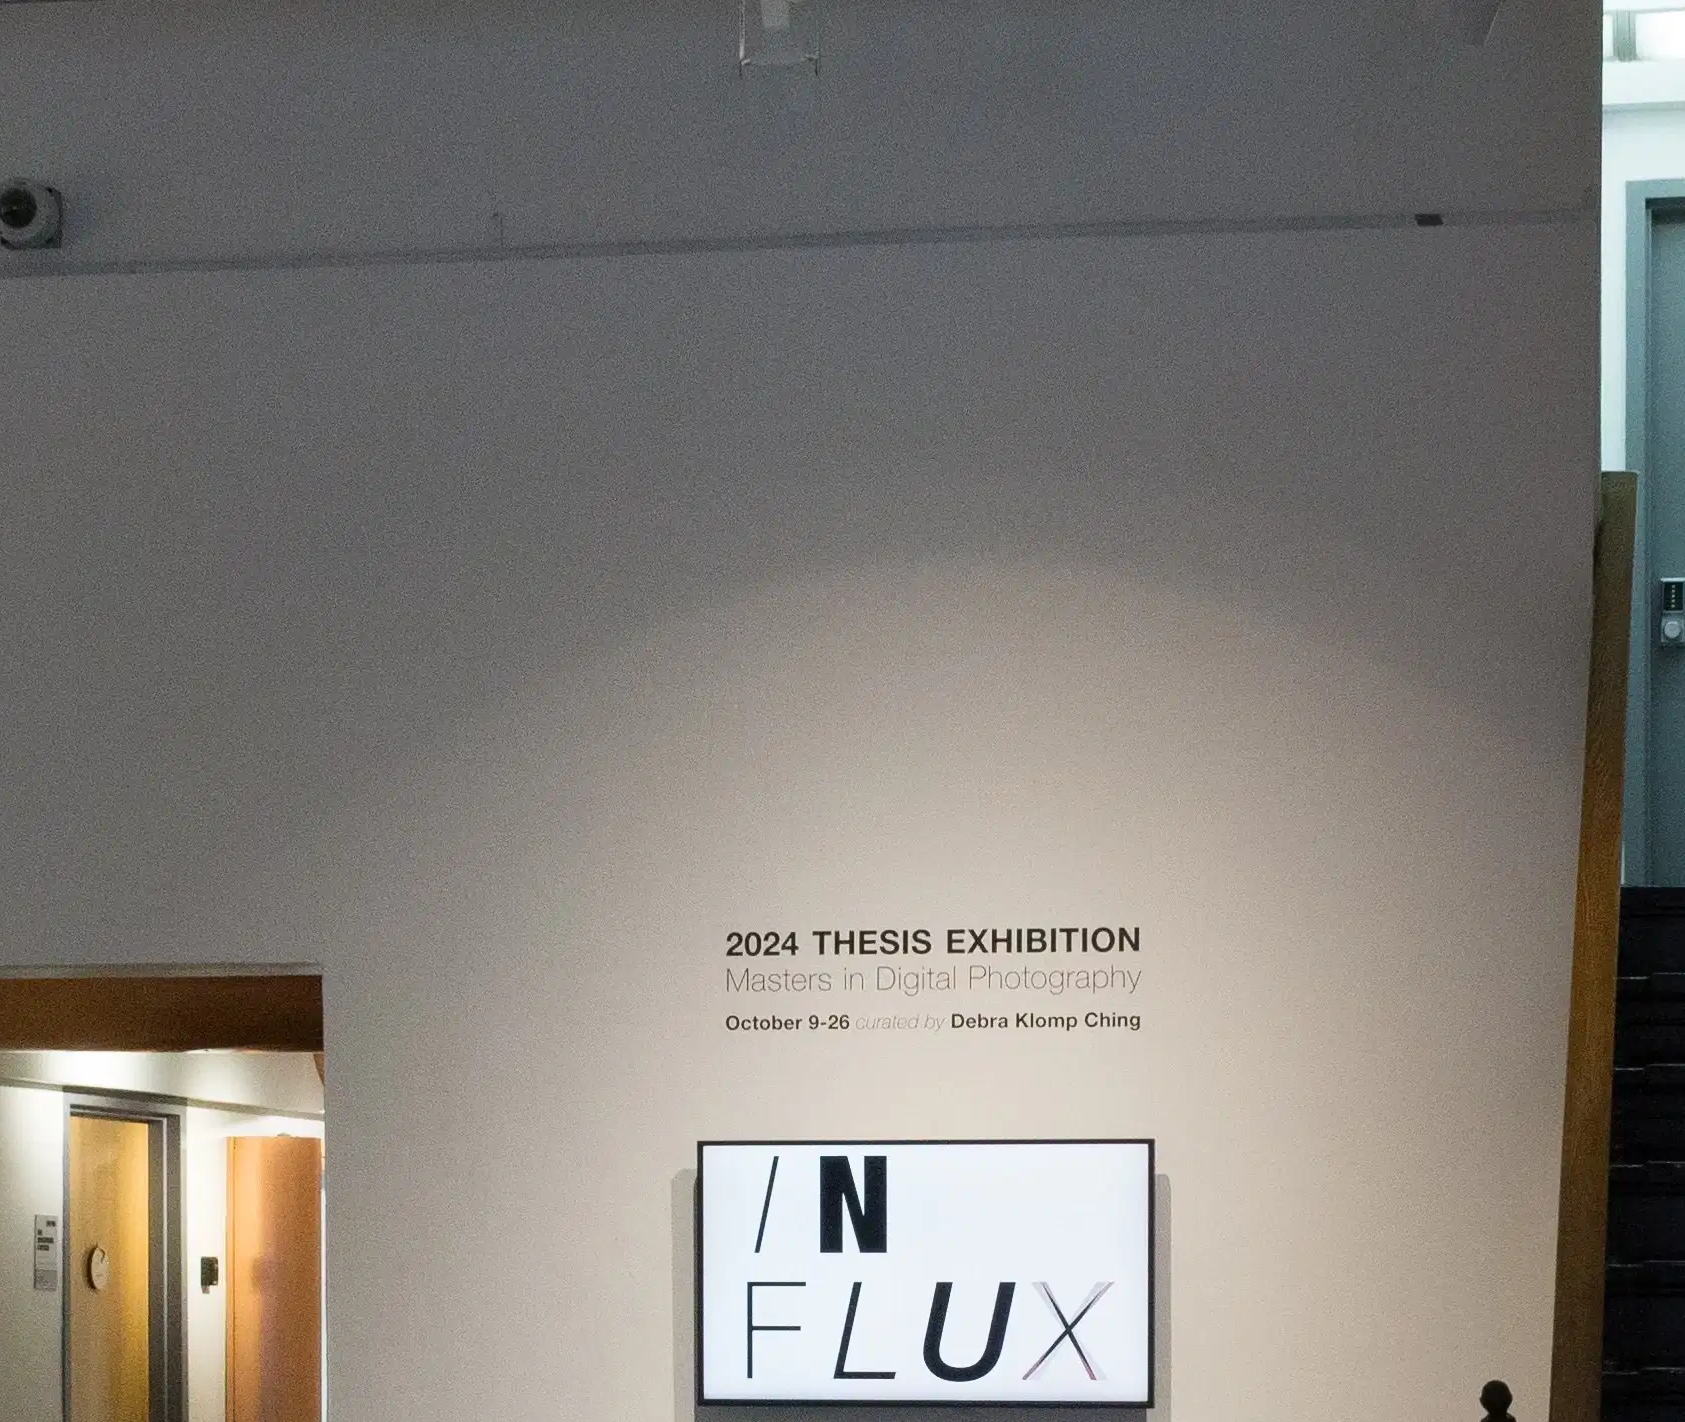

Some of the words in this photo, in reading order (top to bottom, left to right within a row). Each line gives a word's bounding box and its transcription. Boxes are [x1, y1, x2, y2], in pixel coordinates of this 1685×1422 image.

[725, 931, 800, 957] 2024
[812, 928, 932, 955] THESIS
[946, 926, 1141, 954] EXHIBITION
[725, 967, 833, 993] Masters
[843, 966, 865, 991] in
[876, 965, 957, 997] Digital
[968, 964, 1143, 996] Photography
[725, 1014, 803, 1031] October
[807, 1013, 850, 1031] 9-26
[855, 1013, 920, 1030] curated
[923, 1013, 946, 1033] by
[950, 1013, 1009, 1030] Debra
[1015, 1012, 1078, 1032] Klomp
[1084, 1011, 1142, 1032] Ching
[746, 1281, 1115, 1382] FLUX
